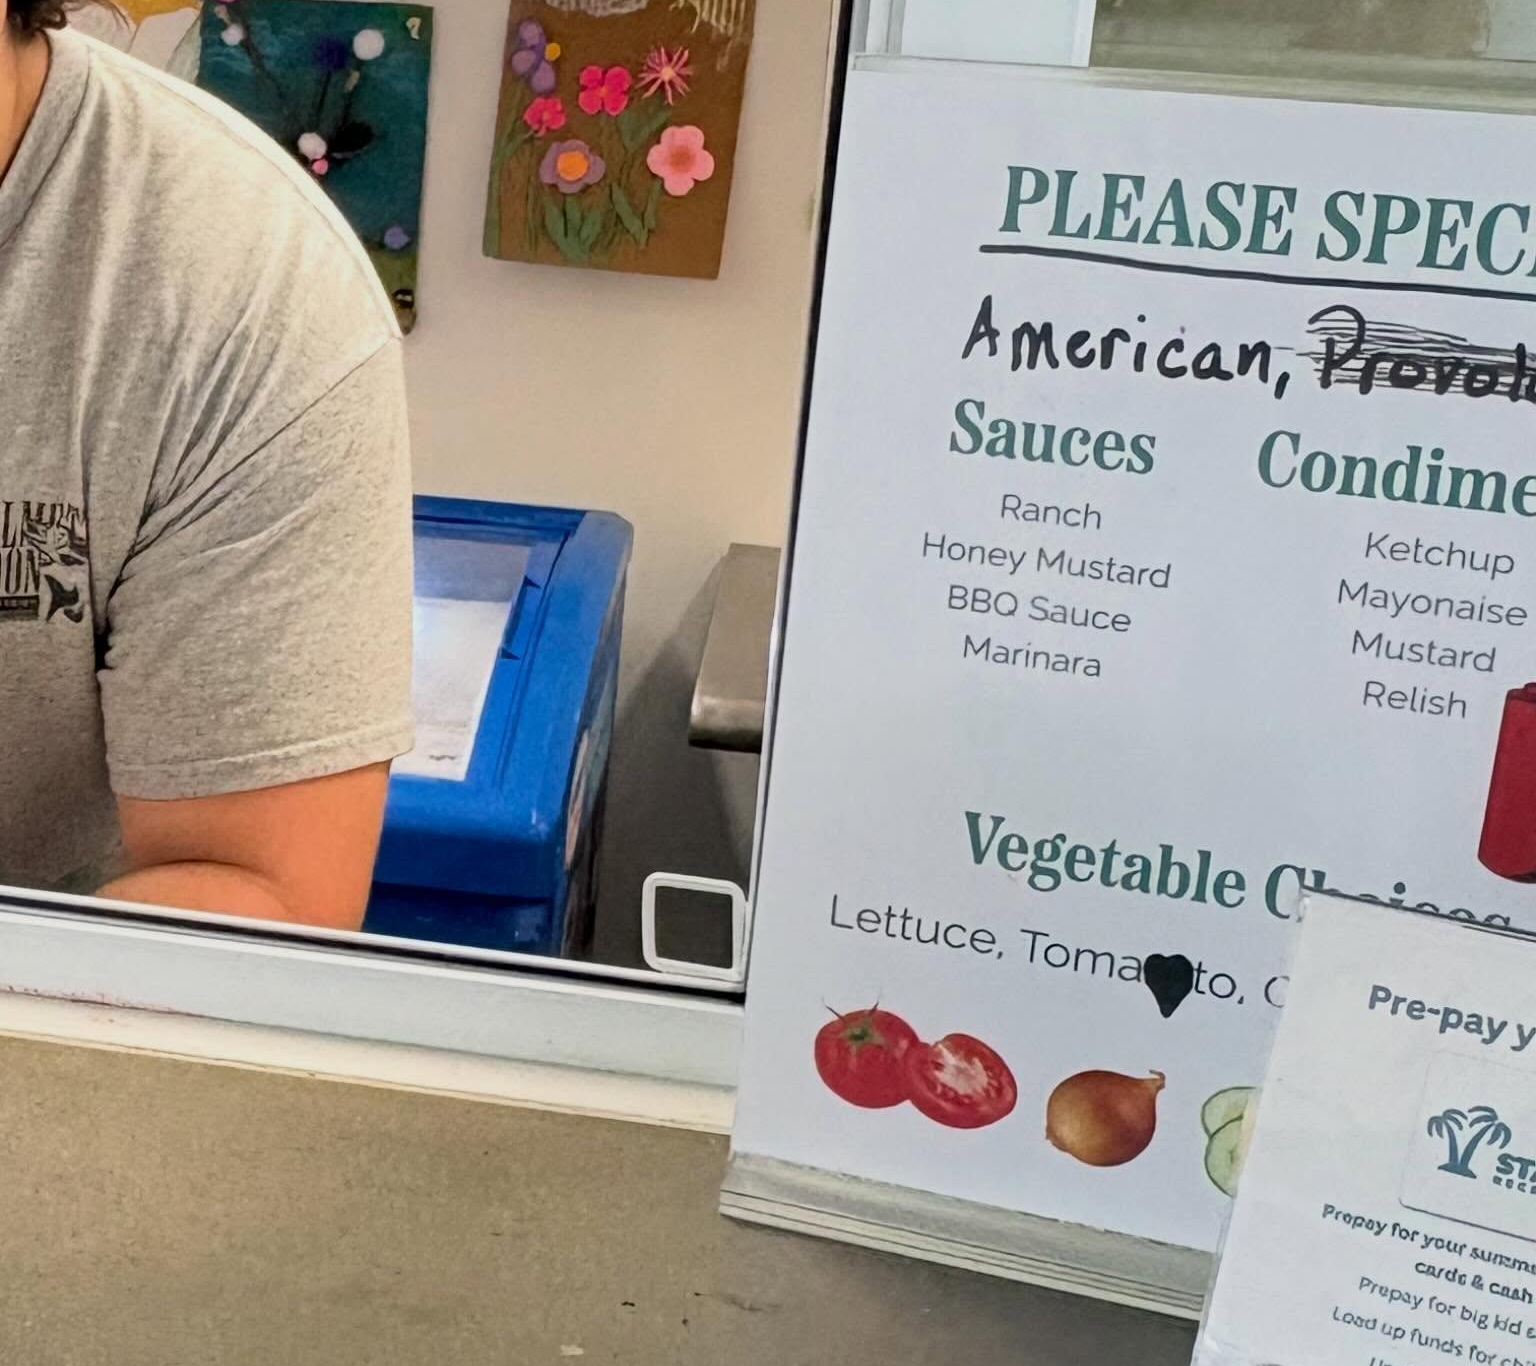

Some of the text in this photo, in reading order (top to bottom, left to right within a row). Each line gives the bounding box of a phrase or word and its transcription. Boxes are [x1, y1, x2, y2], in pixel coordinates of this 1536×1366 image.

[998, 166, 1536, 277] PLEASE SPEC
[962, 295, 1290, 399] American,
[950, 400, 1156, 474] Sauces
[1258, 430, 1536, 516] Condime
[1000, 494, 1102, 530] Ranch
[922, 533, 1172, 589] Honey Mustard
[1364, 532, 1516, 580] Ketchup
[948, 584, 1132, 634] BBQ Sauce
[1337, 579, 1528, 627] Mayonaise
[963, 636, 1101, 679] Marinara
[1352, 630, 1496, 673] Mustard
[1363, 682, 1467, 719] Relish
[964, 811, 1247, 911] Vegetable
[829, 894, 1004, 961] Lettuce,
[1368, 984, 1507, 1045] Pre-pay
[1391, 1223, 1419, 1243] for
[1421, 1234, 1467, 1257] your
[1358, 1276, 1424, 1310] Prepay
[1429, 1296, 1456, 1316] for
[1460, 1306, 1489, 1330] big
[1493, 1314, 1522, 1336] kid
[1332, 1306, 1378, 1331] Load
[1380, 1322, 1406, 1340] up
[1410, 1328, 1463, 1357] funds
[1469, 1345, 1497, 1366] for
